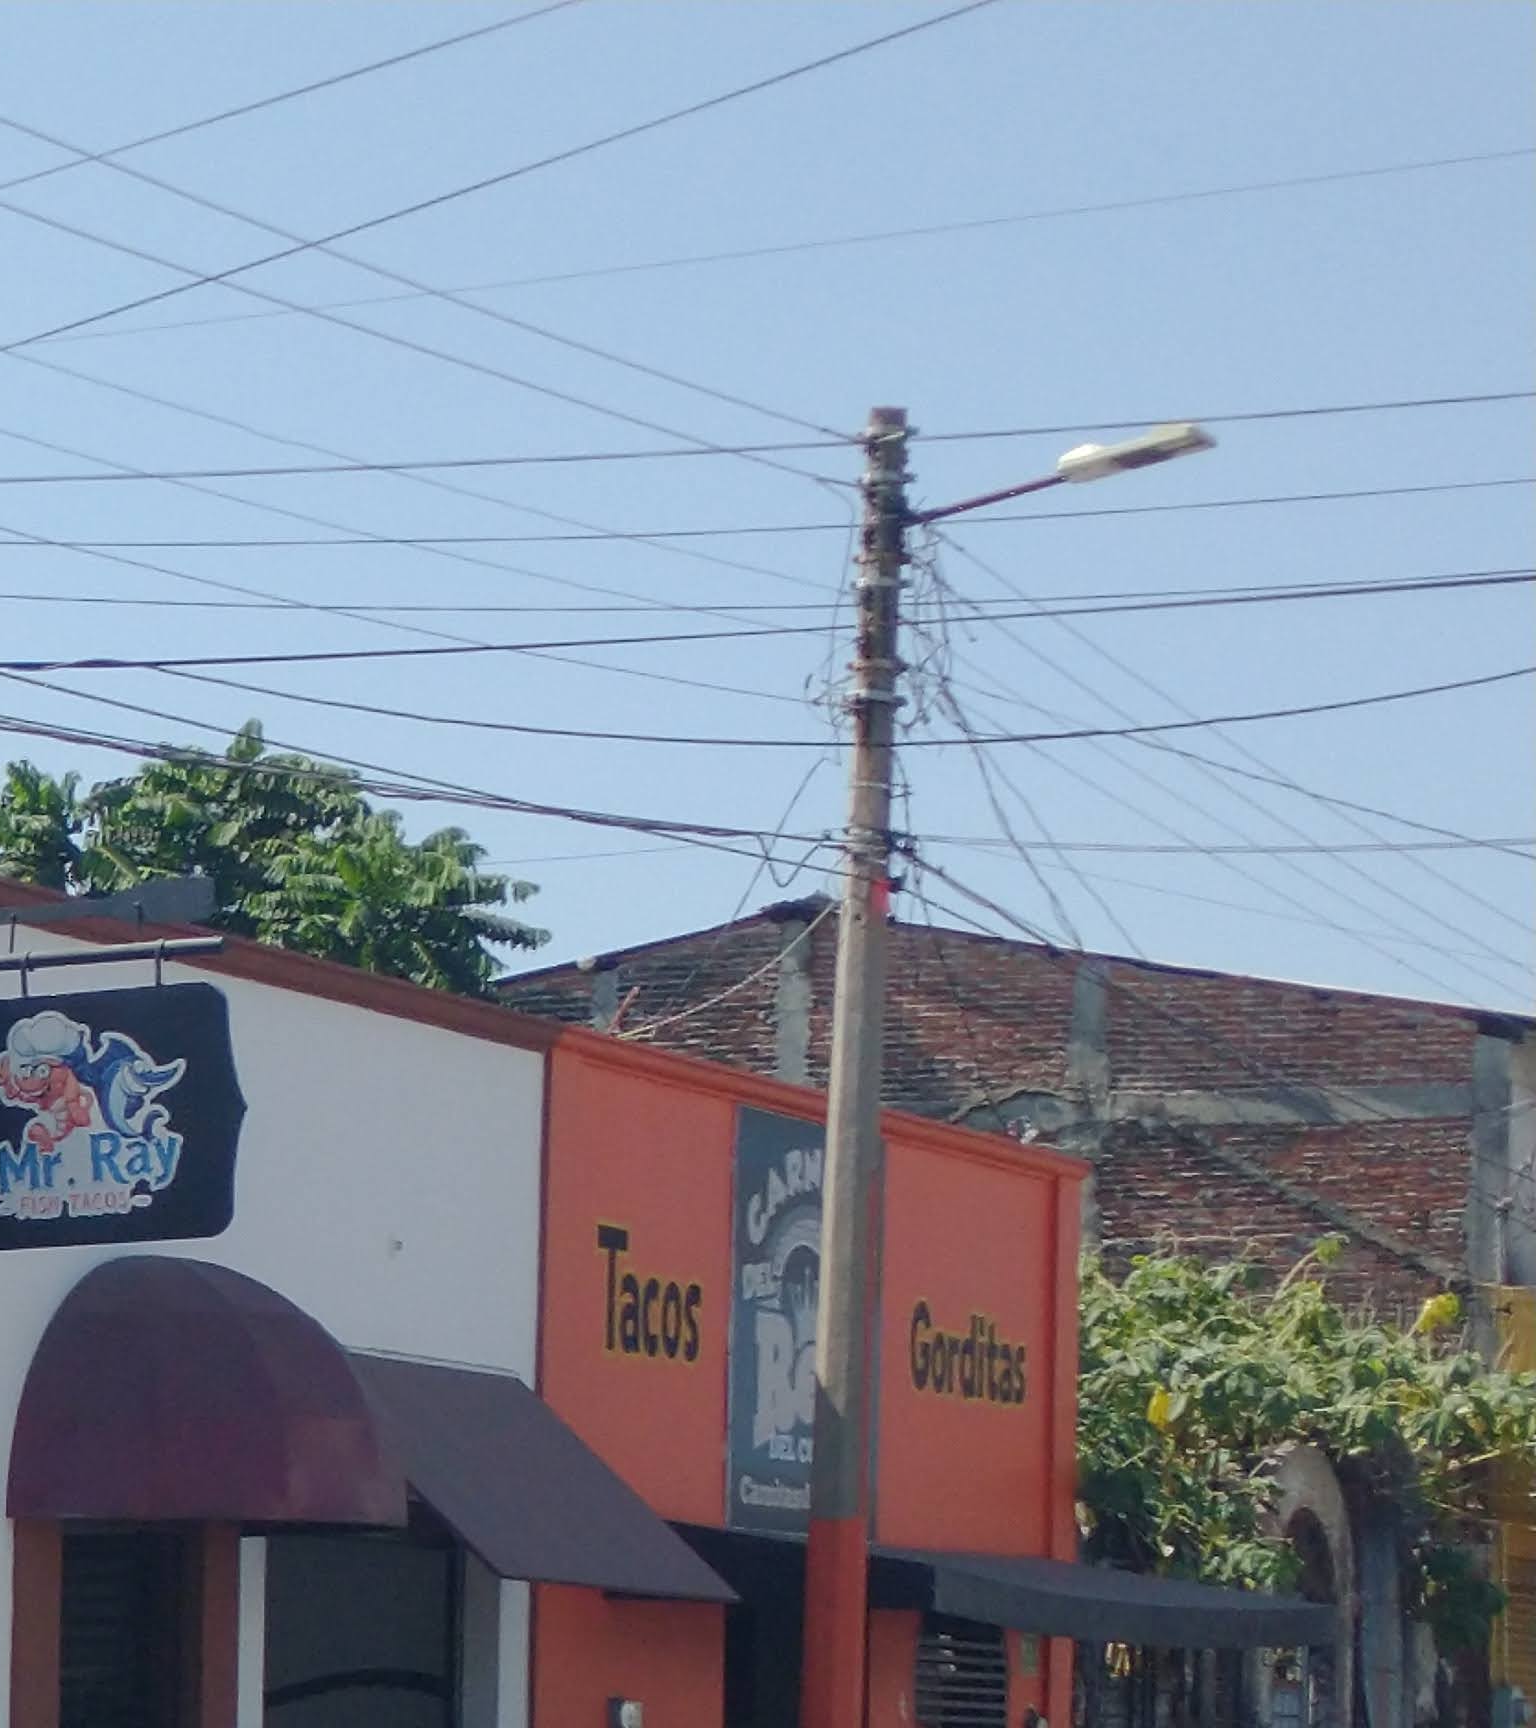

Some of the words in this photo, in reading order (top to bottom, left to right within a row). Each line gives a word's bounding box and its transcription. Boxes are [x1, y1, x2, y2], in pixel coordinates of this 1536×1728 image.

[69, 1191, 128, 1212] TACOS
[89, 1131, 178, 1185] Ray
[747, 1148, 823, 1246] CARN
[597, 1223, 702, 1362] Tacos
[910, 1300, 1026, 1405] Gorditas
